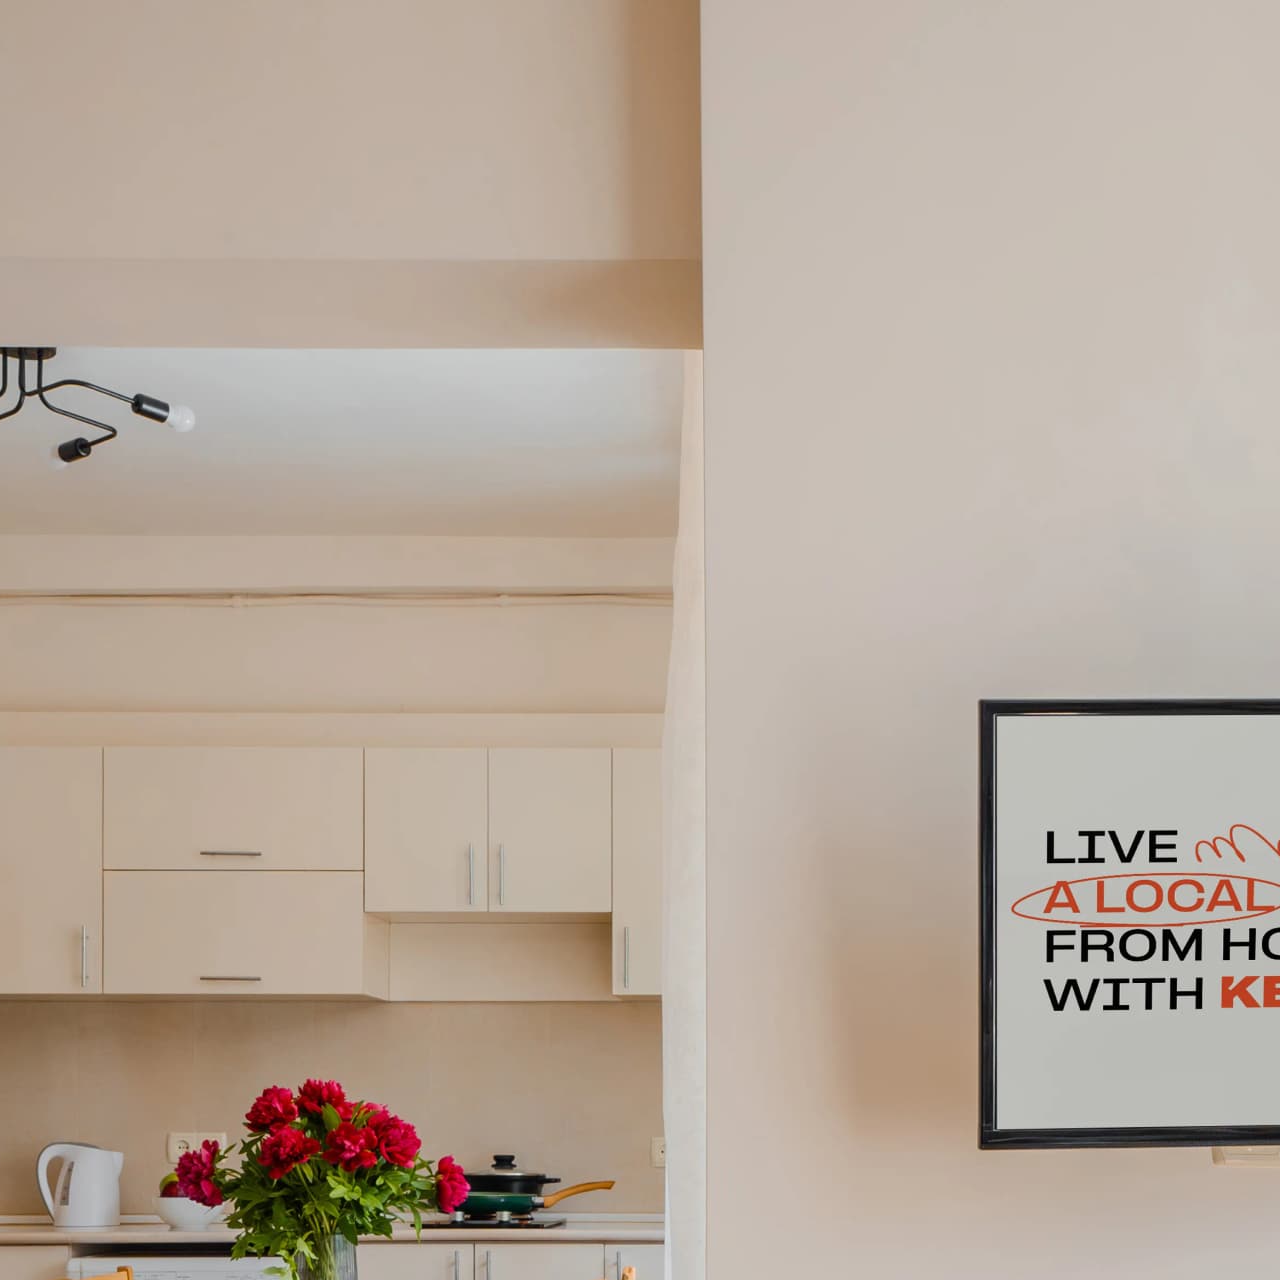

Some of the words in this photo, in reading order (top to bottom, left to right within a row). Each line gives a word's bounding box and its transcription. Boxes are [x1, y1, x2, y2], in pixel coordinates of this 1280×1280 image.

[1046, 829, 1178, 864] LIVE
[1042, 880, 1081, 914] A
[1095, 877, 1276, 913] LOCAL
[1045, 928, 1203, 963] FROM
[1042, 976, 1204, 1012] WITH
